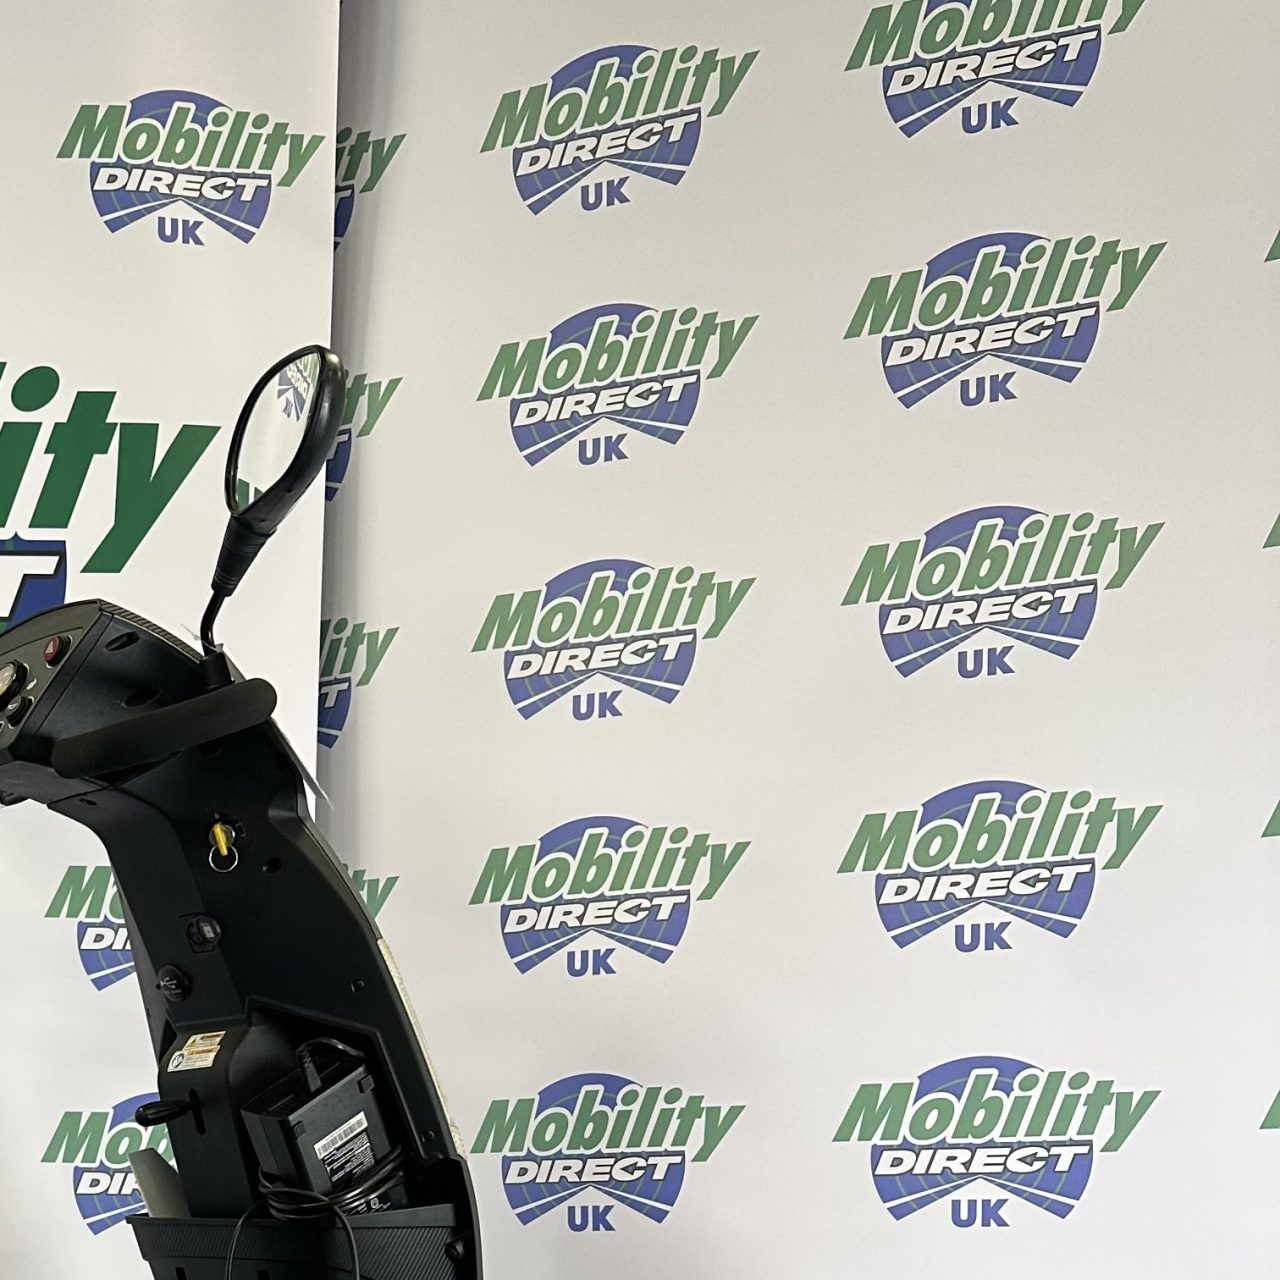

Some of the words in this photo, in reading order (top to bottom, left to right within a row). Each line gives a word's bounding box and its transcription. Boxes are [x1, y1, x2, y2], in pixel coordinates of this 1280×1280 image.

[886, 30, 1099, 97] DIRECT
[480, 45, 760, 153] Mobility
[961, 97, 1020, 134] UK
[56, 104, 326, 187] Mobility
[515, 114, 697, 177] DIRECT
[93, 167, 269, 201] DIRECT
[579, 176, 630, 211] UK
[157, 216, 205, 246] UK
[843, 235, 1169, 341] Mobility
[476, 307, 760, 402] Mobility
[885, 306, 1096, 367] DIRECT
[512, 376, 697, 428] DIRECT
[959, 373, 1018, 408] UK
[577, 433, 629, 467] UK
[840, 512, 1167, 607] Mobility
[471, 566, 757, 653] Mobility
[882, 584, 1093, 636] DIRECT
[507, 634, 695, 680] DIRECT
[957, 645, 1016, 679] UK
[571, 690, 624, 721] UK
[836, 789, 1165, 875] Mobility
[468, 825, 751, 906] Mobility
[878, 863, 1092, 906] DIRECT
[502, 895, 690, 934] DIRECT
[954, 921, 1013, 954] UK
[566, 947, 617, 977] UK
[471, 1086, 747, 1164] Mobility
[831, 1069, 1162, 1153] Mobility
[502, 1155, 686, 1184] DIRECT
[873, 1144, 1091, 1177] DIRECT
[567, 1204, 616, 1232] UK
[950, 1198, 1009, 1229] UK
